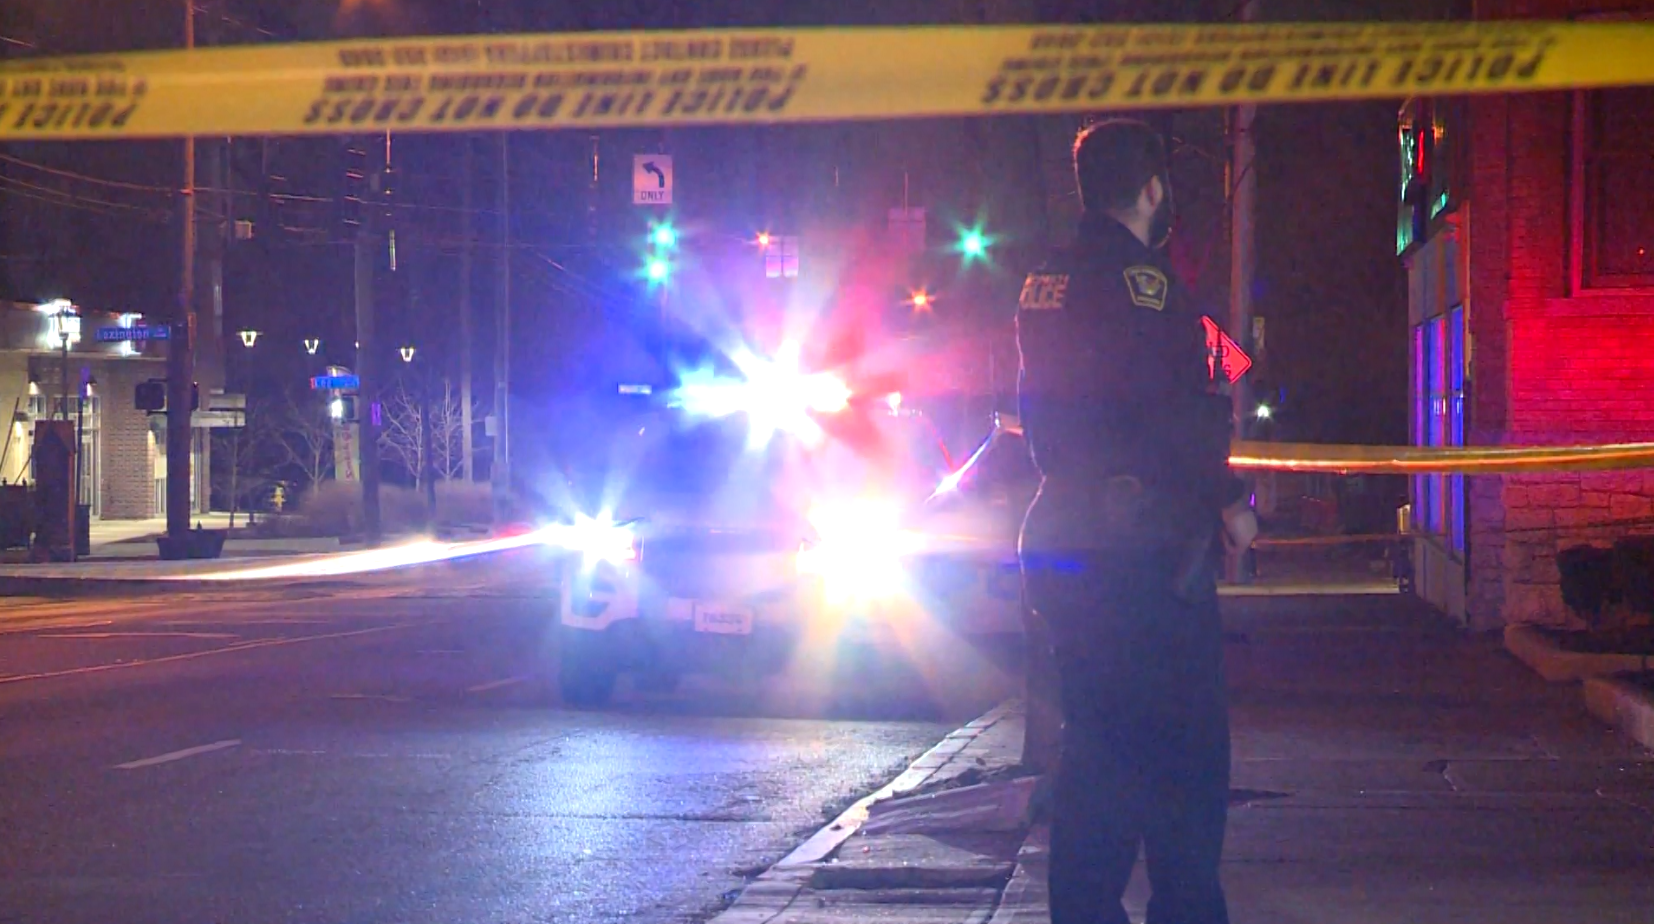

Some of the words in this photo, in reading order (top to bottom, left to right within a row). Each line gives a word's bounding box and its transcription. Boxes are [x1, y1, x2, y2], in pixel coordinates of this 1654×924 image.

[1217, 64, 1277, 94] DO
[1287, 62, 1379, 90] LINE
[1391, 51, 1543, 88] POLICE
[981, 73, 1115, 103] CROSS
[1123, 70, 1208, 97] NOT
[303, 98, 425, 124] CROSS
[431, 96, 503, 122] NOT
[512, 94, 564, 119] DO
[572, 91, 654, 118] LINE
[660, 85, 794, 115] POLICE
[12, 103, 138, 129] POLICE
[641, 190, 664, 201] ONLY
[1019, 285, 1066, 310] OLICE
